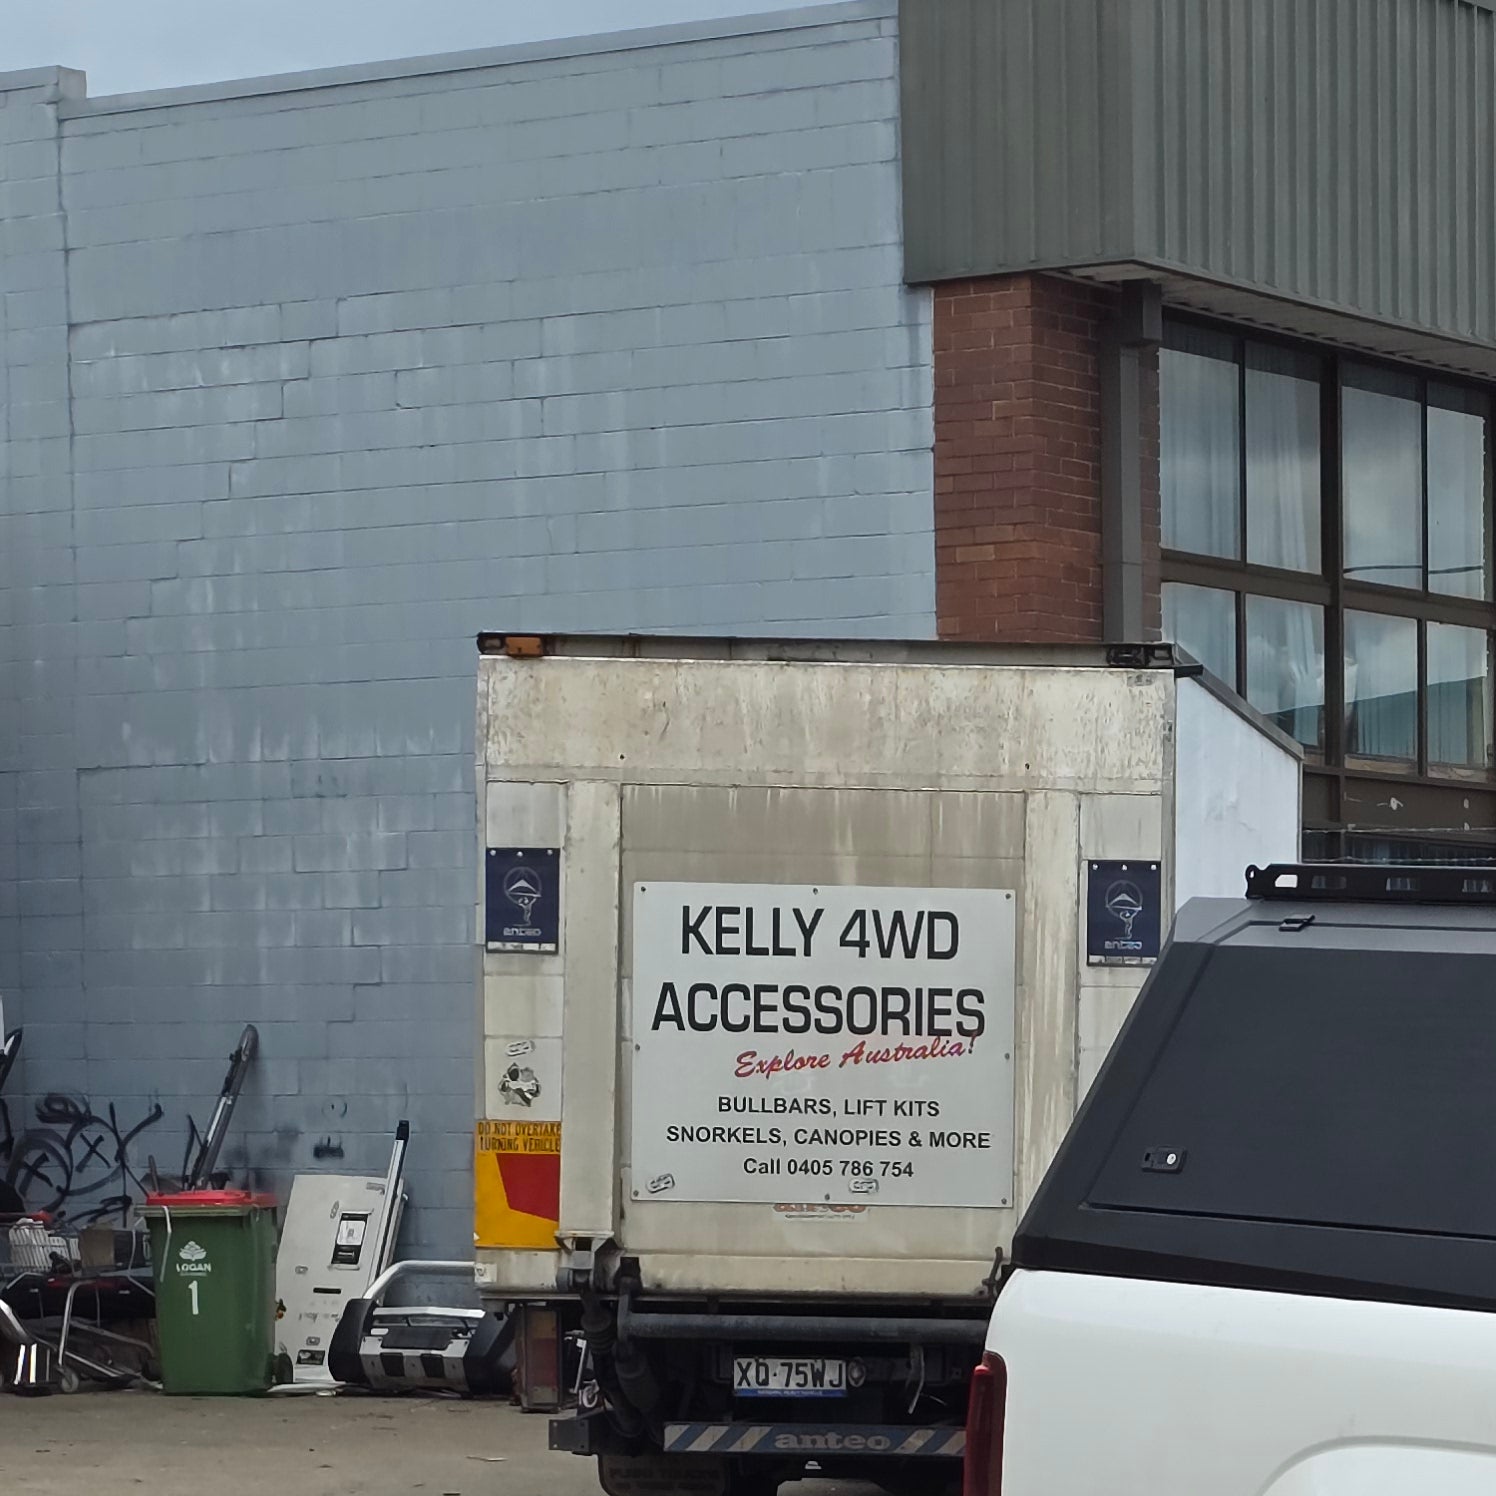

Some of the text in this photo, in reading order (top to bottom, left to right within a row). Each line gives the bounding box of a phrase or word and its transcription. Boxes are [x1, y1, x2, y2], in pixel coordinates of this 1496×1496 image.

[681, 905, 960, 960] KELLY 4WD
[650, 981, 986, 1038] ACCESSORIES
[734, 1033, 977, 1080] Explore Australia!
[718, 1096, 940, 1118] BULLBARS, LIFT KITS
[478, 1121, 491, 1136] DO
[494, 1122, 512, 1136] NOT
[666, 1125, 991, 1149] SNORKELS, CANOPIES & MORE
[480, 1136, 519, 1151] TURNING
[743, 1157, 914, 1178] Call 0405 786 754
[188, 1280, 199, 1315] 1
[774, 1432, 891, 1450] anteo
